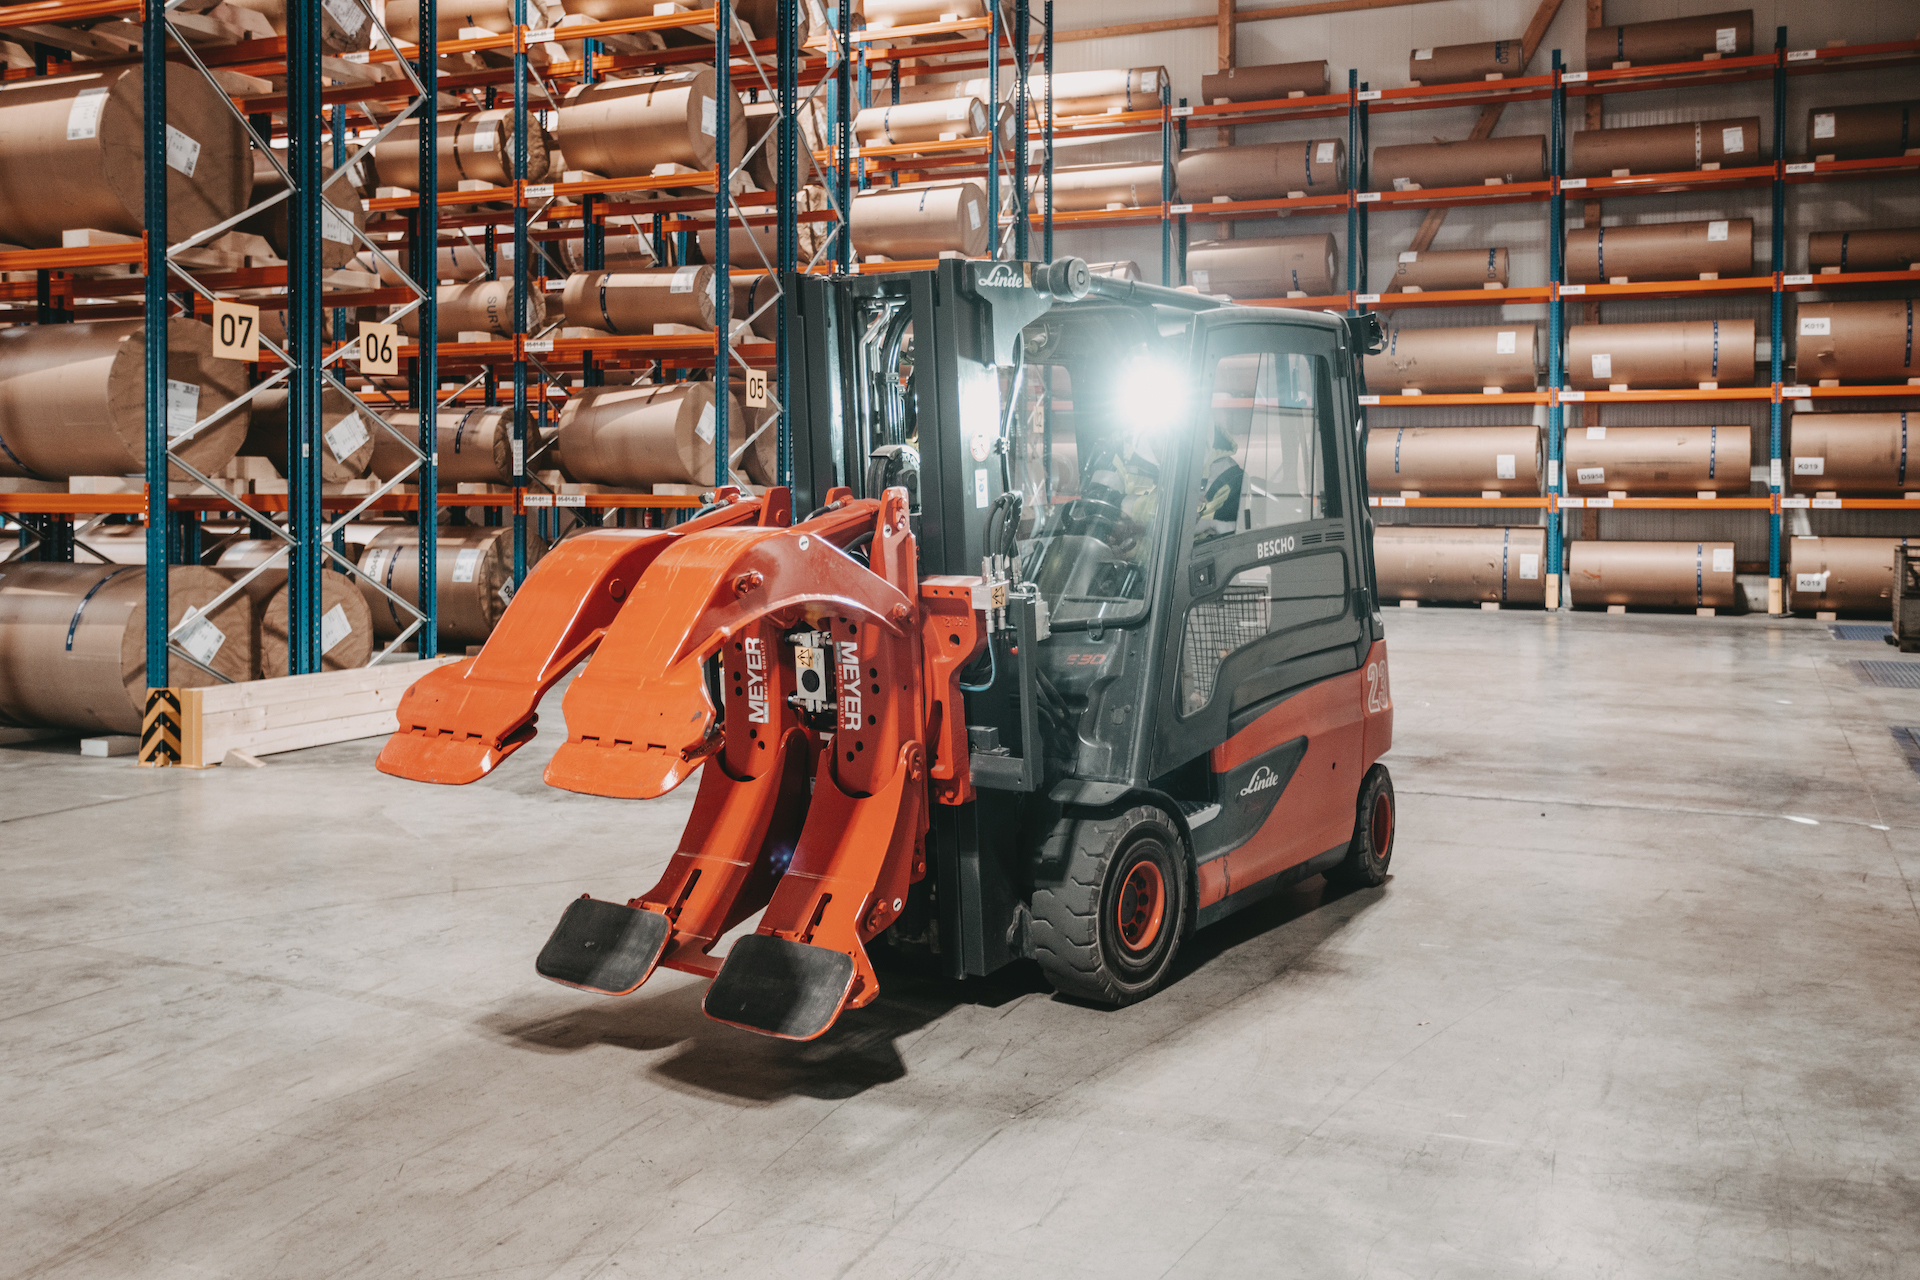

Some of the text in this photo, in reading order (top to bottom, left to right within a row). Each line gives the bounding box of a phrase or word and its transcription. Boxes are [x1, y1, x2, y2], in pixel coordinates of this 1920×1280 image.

[978, 264, 1022, 288] Linde
[220, 314, 253, 348] 07
[366, 333, 392, 363] 06
[750, 377, 763, 399] 05
[1580, 473, 1604, 481] D5958
[1257, 536, 1295, 559] BESCHO
[745, 637, 765, 723] MEYER
[840, 641, 862, 731] MEYER
[1367, 660, 1388, 713] 23
[1240, 766, 1279, 796] Linde
